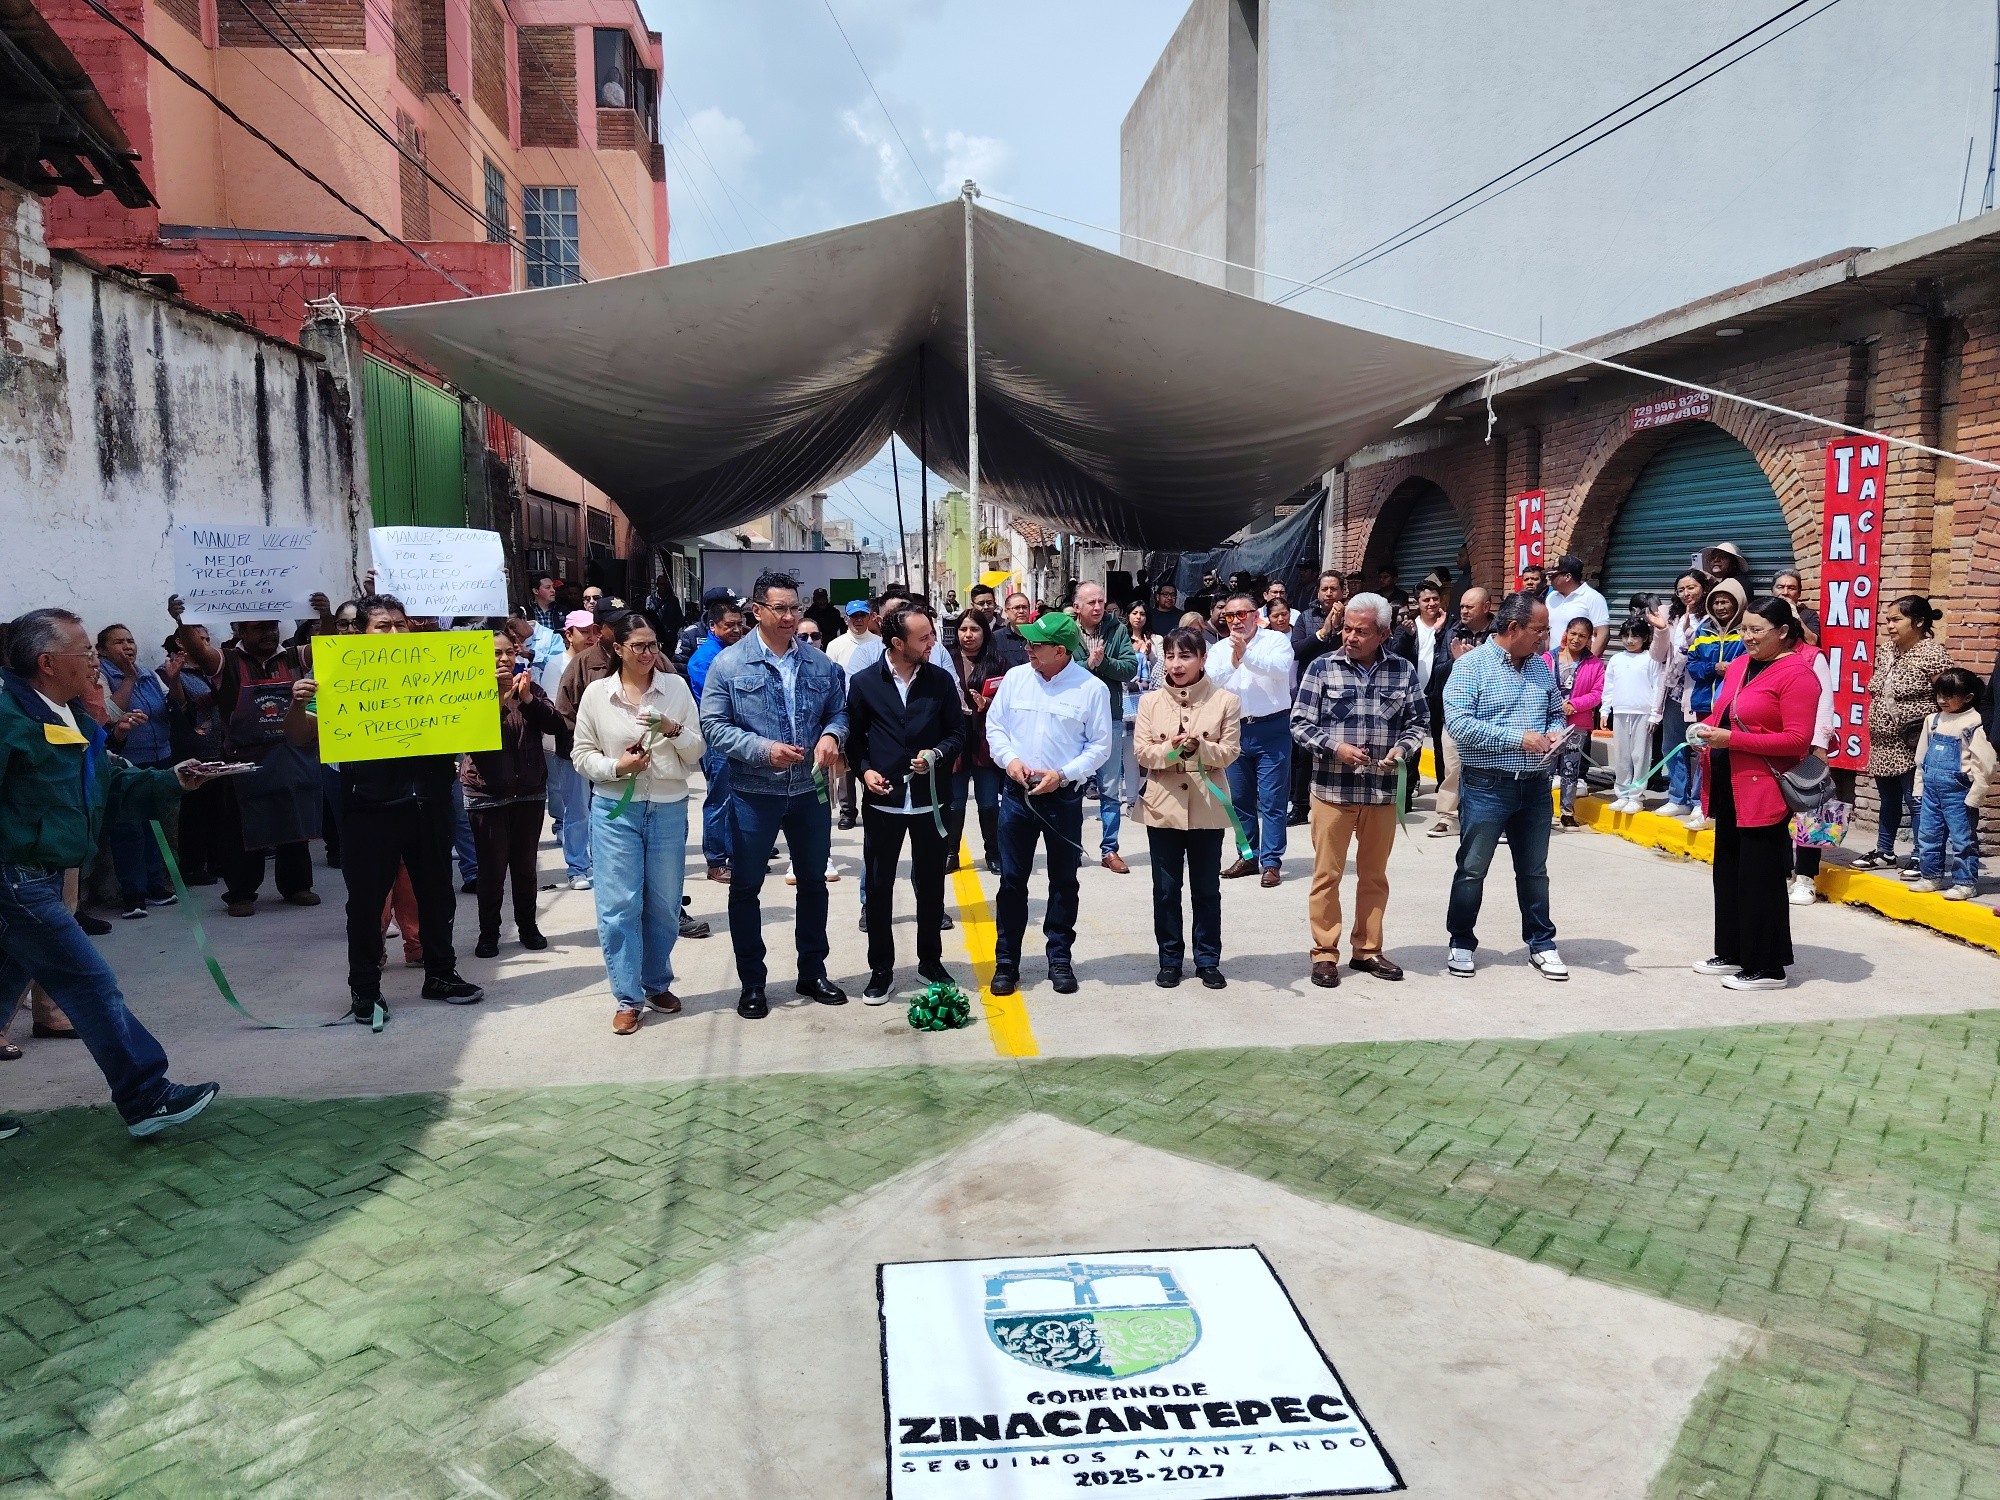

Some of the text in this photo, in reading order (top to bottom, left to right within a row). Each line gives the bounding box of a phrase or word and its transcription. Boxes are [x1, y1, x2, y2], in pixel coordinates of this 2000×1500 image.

[1633, 391, 1710, 418] 729 996 8226
[1633, 416, 1652, 429] 722
[205, 555, 254, 567] MEJOR
[392, 550, 453, 562] POR ESO
[193, 600, 293, 613] ZINACANTEPEC
[405, 595, 457, 605] LO APOYA
[1847, 444, 1881, 758] NACIONALES
[333, 665, 485, 693] SEGIR APOYANDO
[337, 703, 348, 716] A
[359, 694, 435, 713] NUESTRA
[898, 1394, 1350, 1445] ZINACANTEPEC
[901, 1437, 1367, 1474] SEGUIMOS AVANZANDO
[1073, 1464, 1225, 1487] 2025-2027
